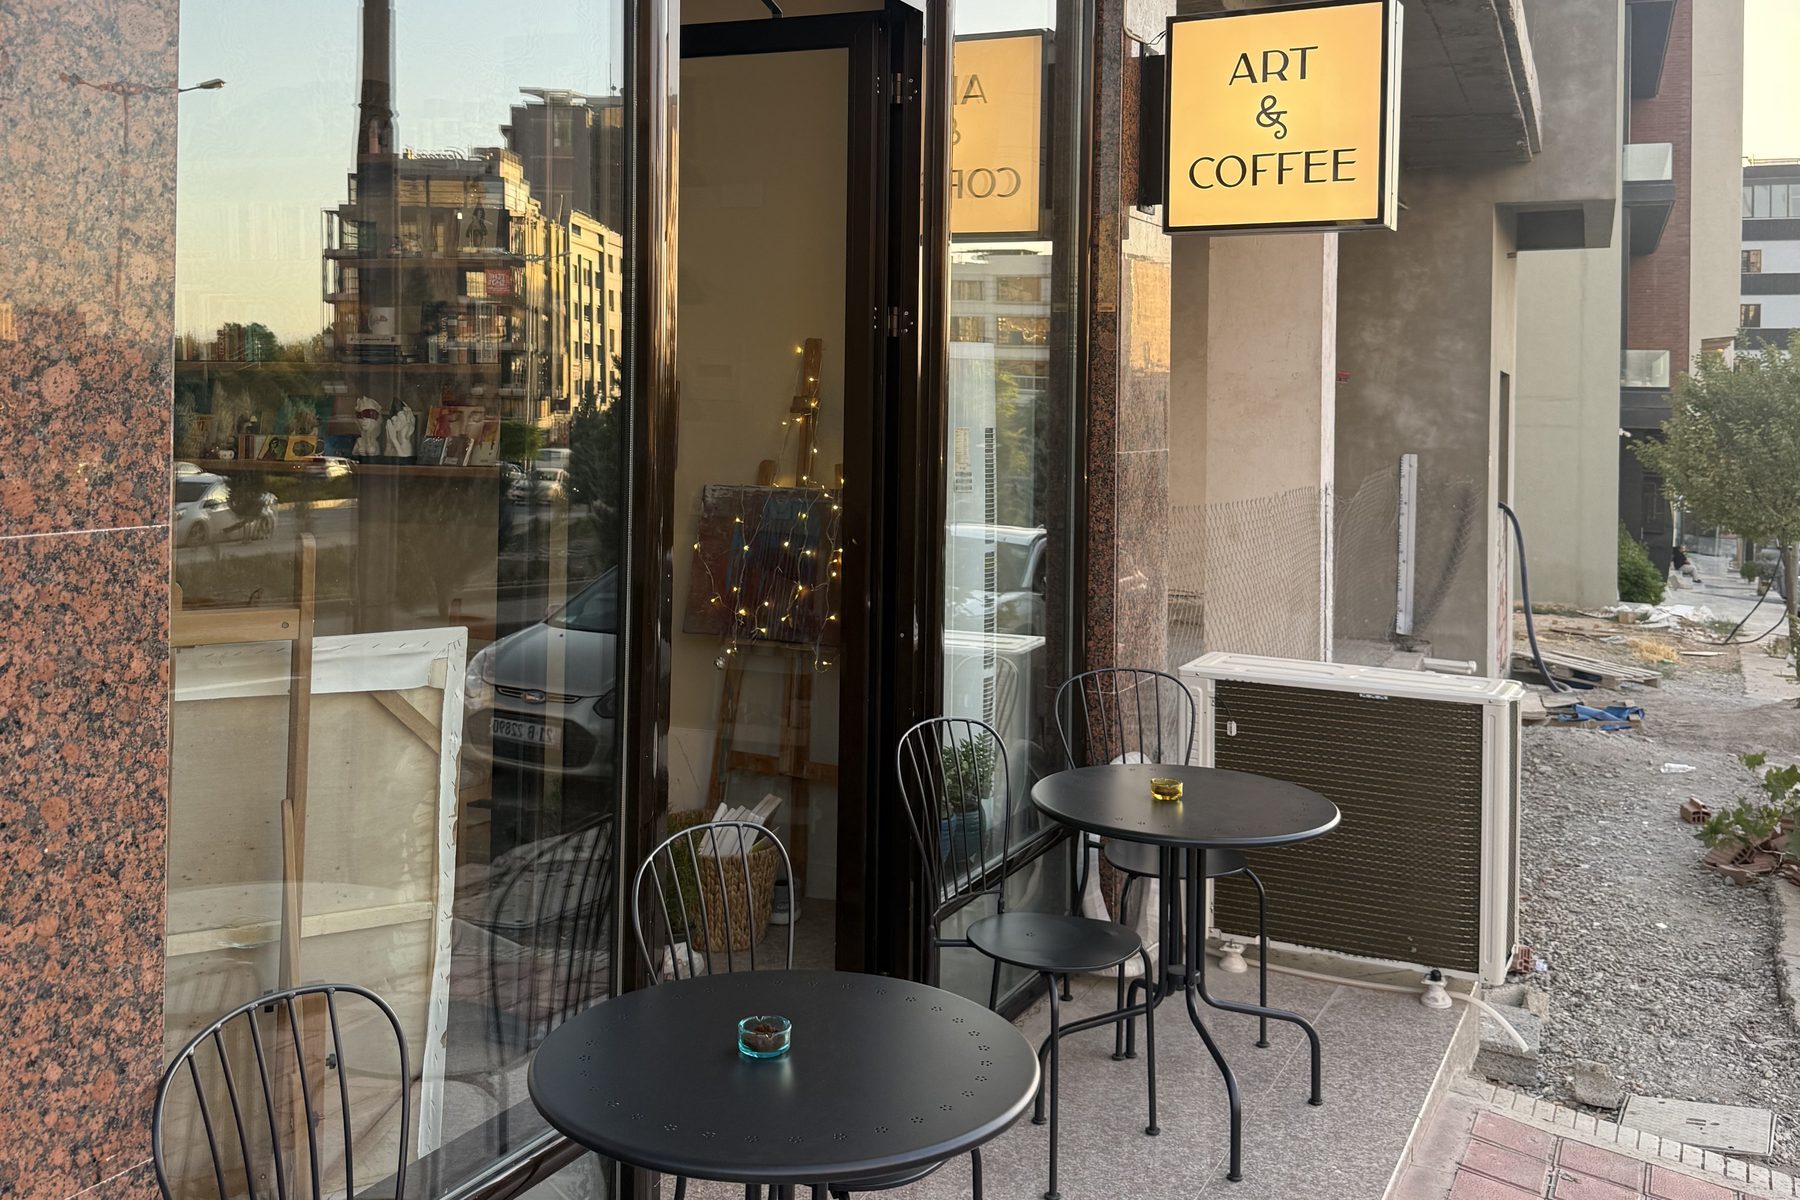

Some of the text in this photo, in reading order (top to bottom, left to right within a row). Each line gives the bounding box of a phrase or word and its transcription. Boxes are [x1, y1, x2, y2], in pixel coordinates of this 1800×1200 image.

[1228, 46, 1319, 86] ART
[1256, 94, 1288, 140] &
[1188, 148, 1357, 189] COFFEE
